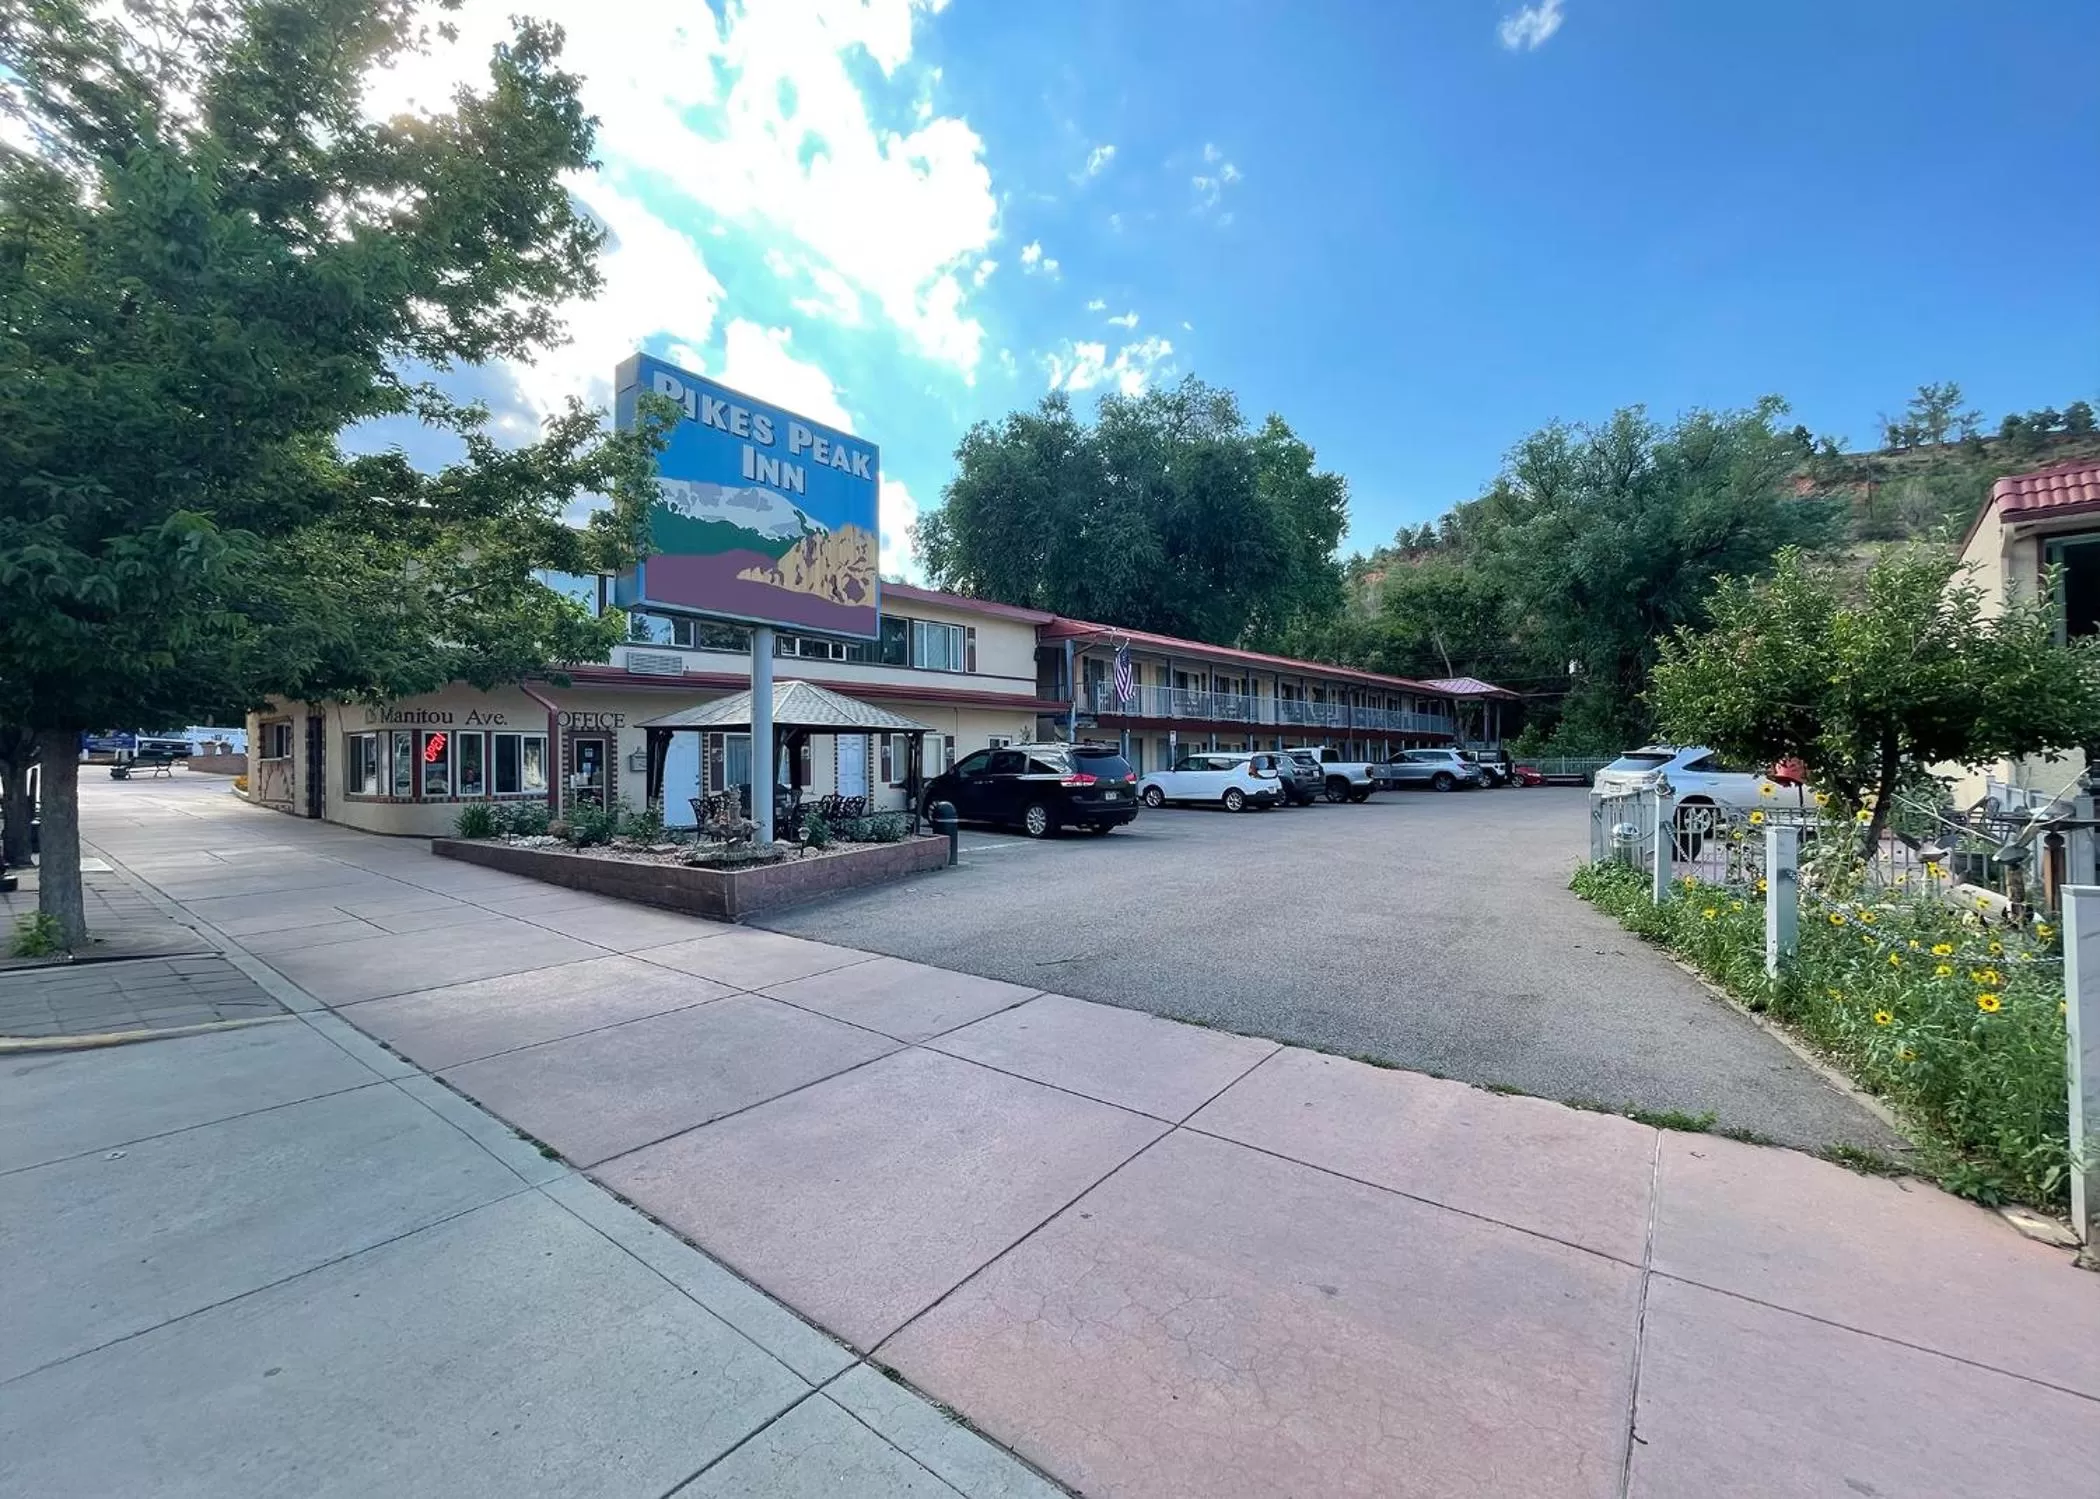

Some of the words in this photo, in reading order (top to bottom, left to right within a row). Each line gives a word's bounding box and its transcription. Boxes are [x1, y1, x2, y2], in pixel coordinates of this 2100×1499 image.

[653, 370, 776, 446] PIKES
[788, 421, 872, 481] PEAK
[742, 444, 806, 496] INN
[380, 707, 453, 725] Manitou
[465, 708, 508, 726] Ave.
[558, 711, 626, 729] OFFICE
[423, 731, 447, 763] OPEN
